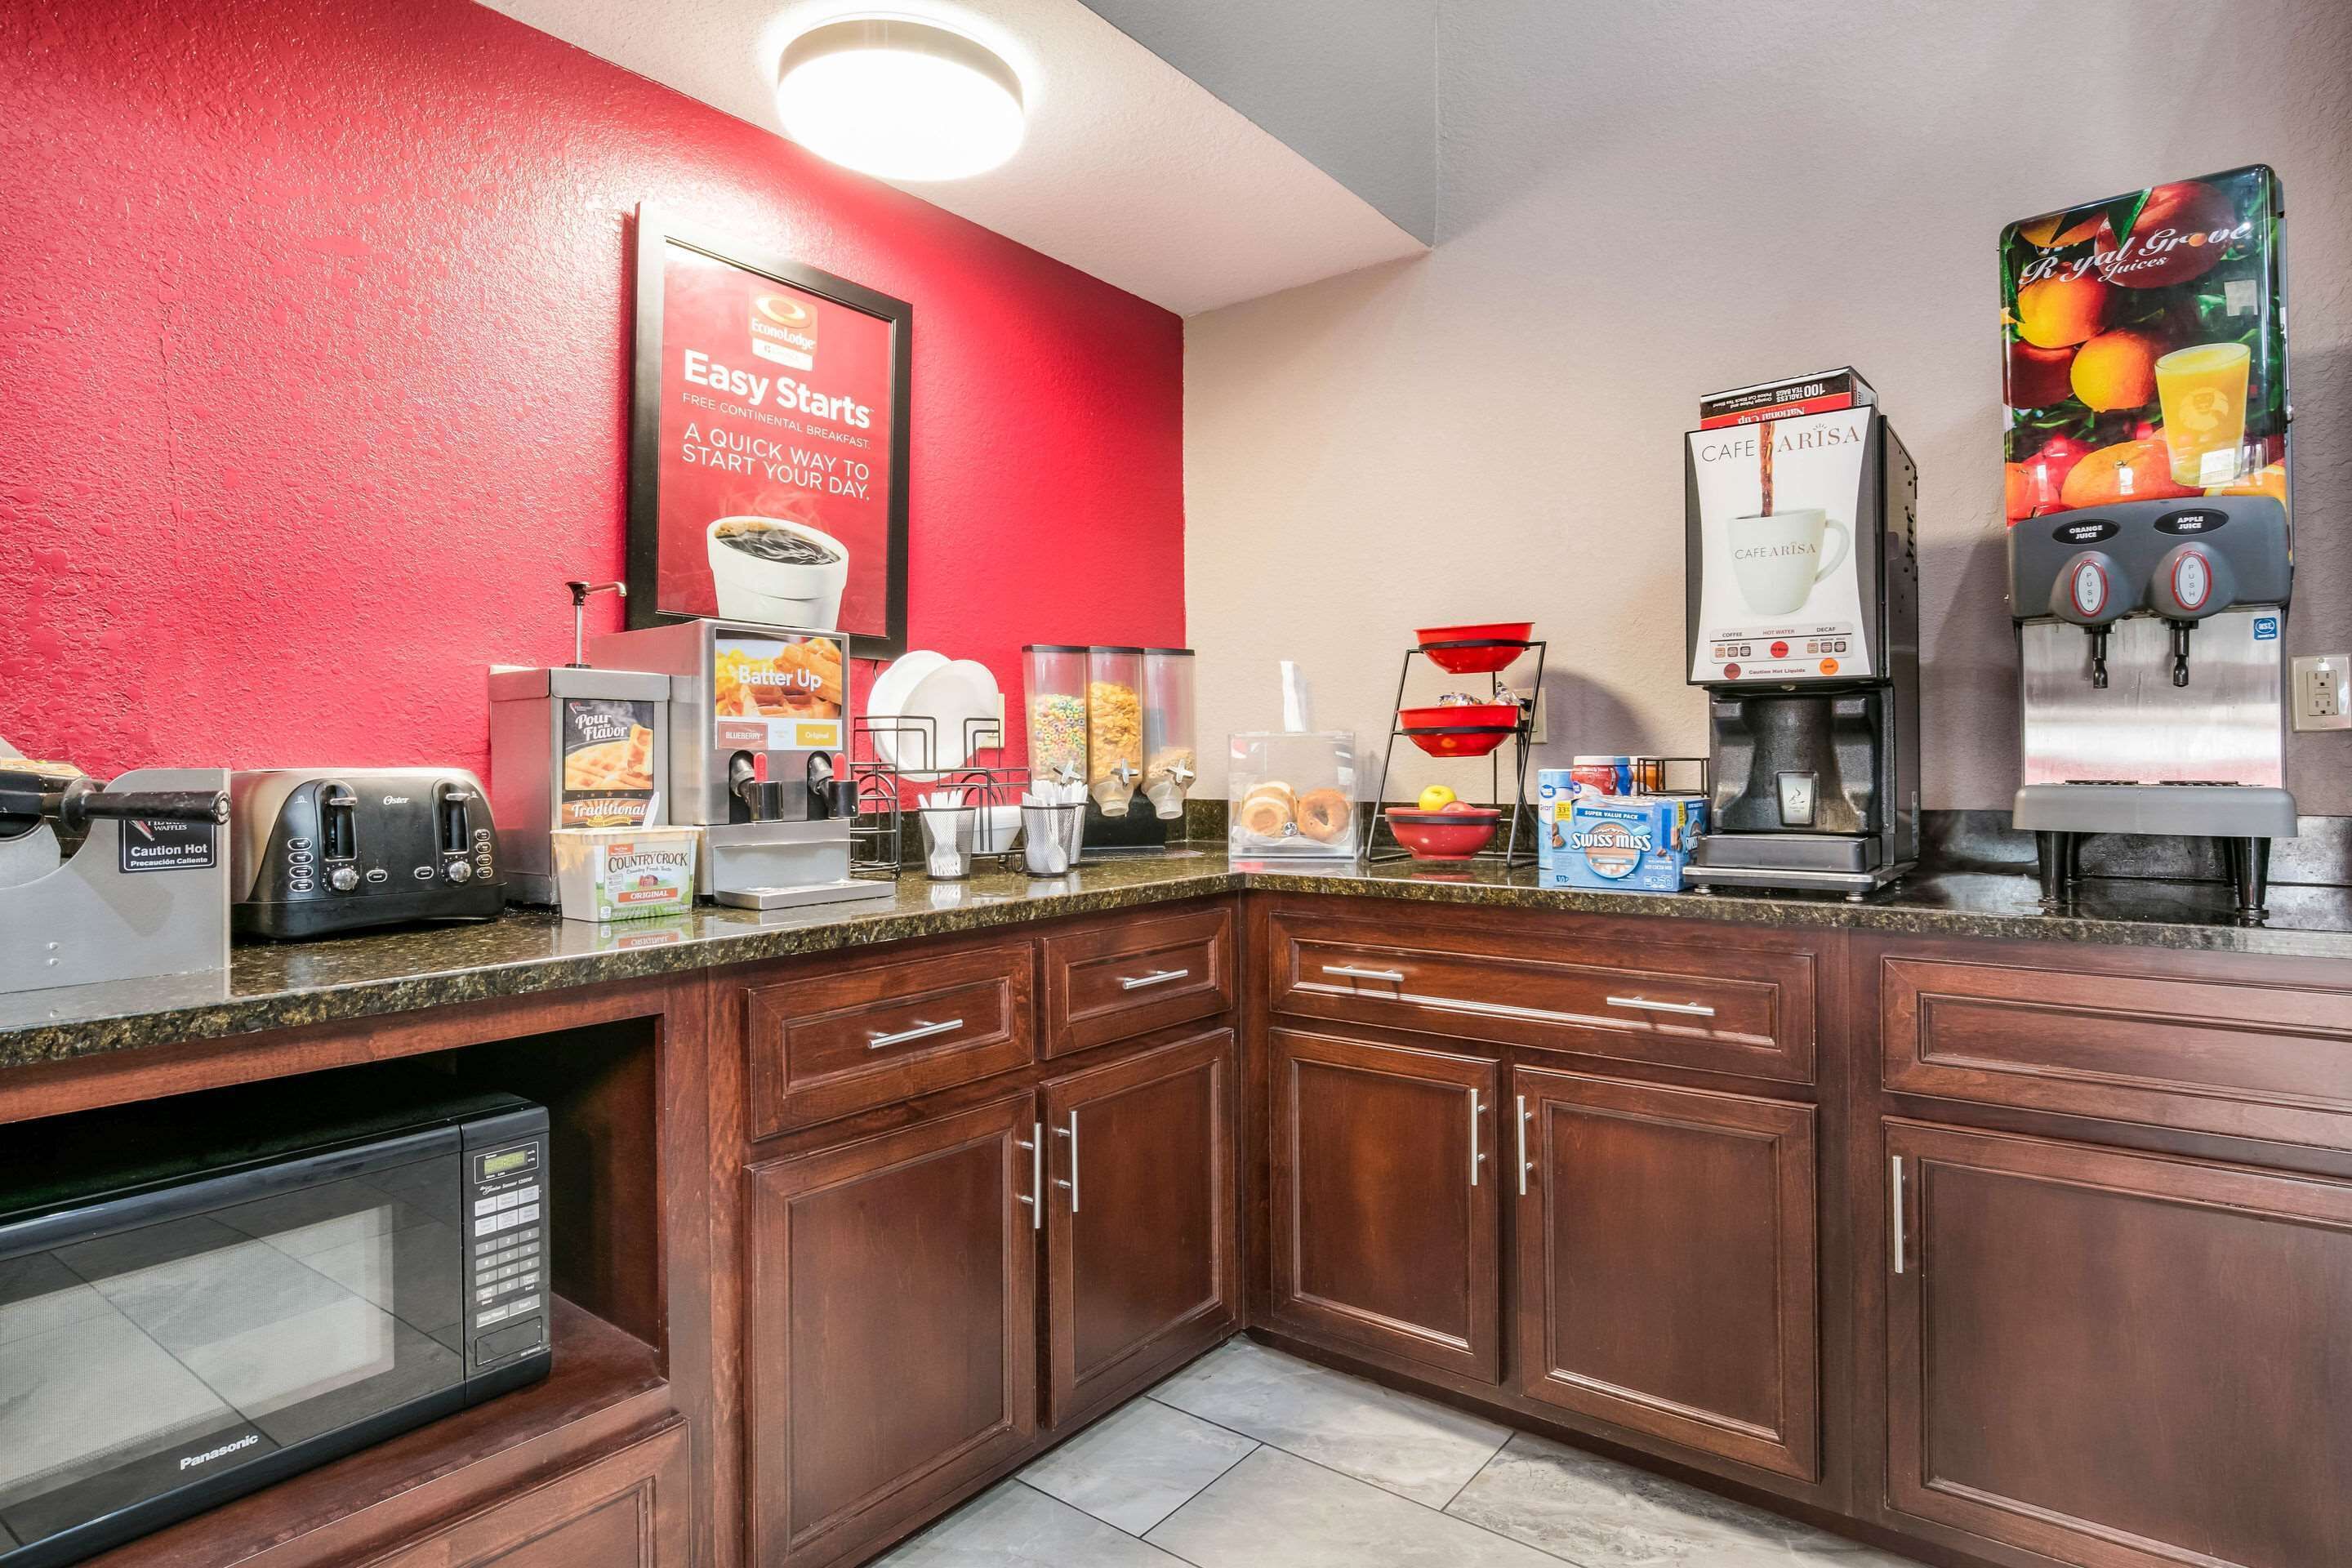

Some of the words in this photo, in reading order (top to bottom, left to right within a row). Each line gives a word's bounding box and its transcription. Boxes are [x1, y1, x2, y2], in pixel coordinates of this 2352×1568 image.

[2098, 255, 2168, 283] Juices
[684, 349, 769, 406] Easy
[776, 376, 871, 429] Starts
[1775, 388, 1792, 397] BAGS
[1792, 385, 1803, 394] TEA
[1803, 383, 1826, 397] 100
[1776, 391, 1803, 403] TAGLESS
[1762, 406, 1805, 421] National
[683, 392, 716, 410] FREE
[719, 402, 803, 432] CONTINENTAL
[806, 424, 871, 450] BREAKFAST.
[1701, 439, 1755, 462] CAFE
[1778, 424, 1861, 452] ARISA
[684, 423, 701, 443] A
[710, 429, 782, 461] QUICK
[790, 447, 837, 474] WAY
[844, 460, 869, 480] TO
[683, 444, 755, 475] START
[763, 461, 822, 490] YOUR
[829, 476, 871, 501] DAY.
[2177, 515, 2203, 523] APPLE
[2178, 522, 2203, 530] JUICE
[2069, 525, 2103, 534] ORANGE
[2075, 532, 2097, 540] JUICE
[1735, 547, 1766, 560] CAFE
[1770, 542, 1816, 556] ARISA
[737, 666, 794, 687] Batter
[796, 668, 823, 692] Up
[575, 714, 612, 729] Pour
[583, 726, 627, 742] Flavor
[383, 795, 410, 805] Oster
[572, 803, 647, 817] Traditional
[131, 844, 181, 857] Caution
[185, 844, 208, 854] Hot
[130, 859, 176, 867] Precaución
[608, 853, 657, 874] COUNTRY
[656, 853, 688, 866] CROCK
[630, 890, 669, 900] ORIGINAL
[180, 1435, 259, 1470] Panasonic
